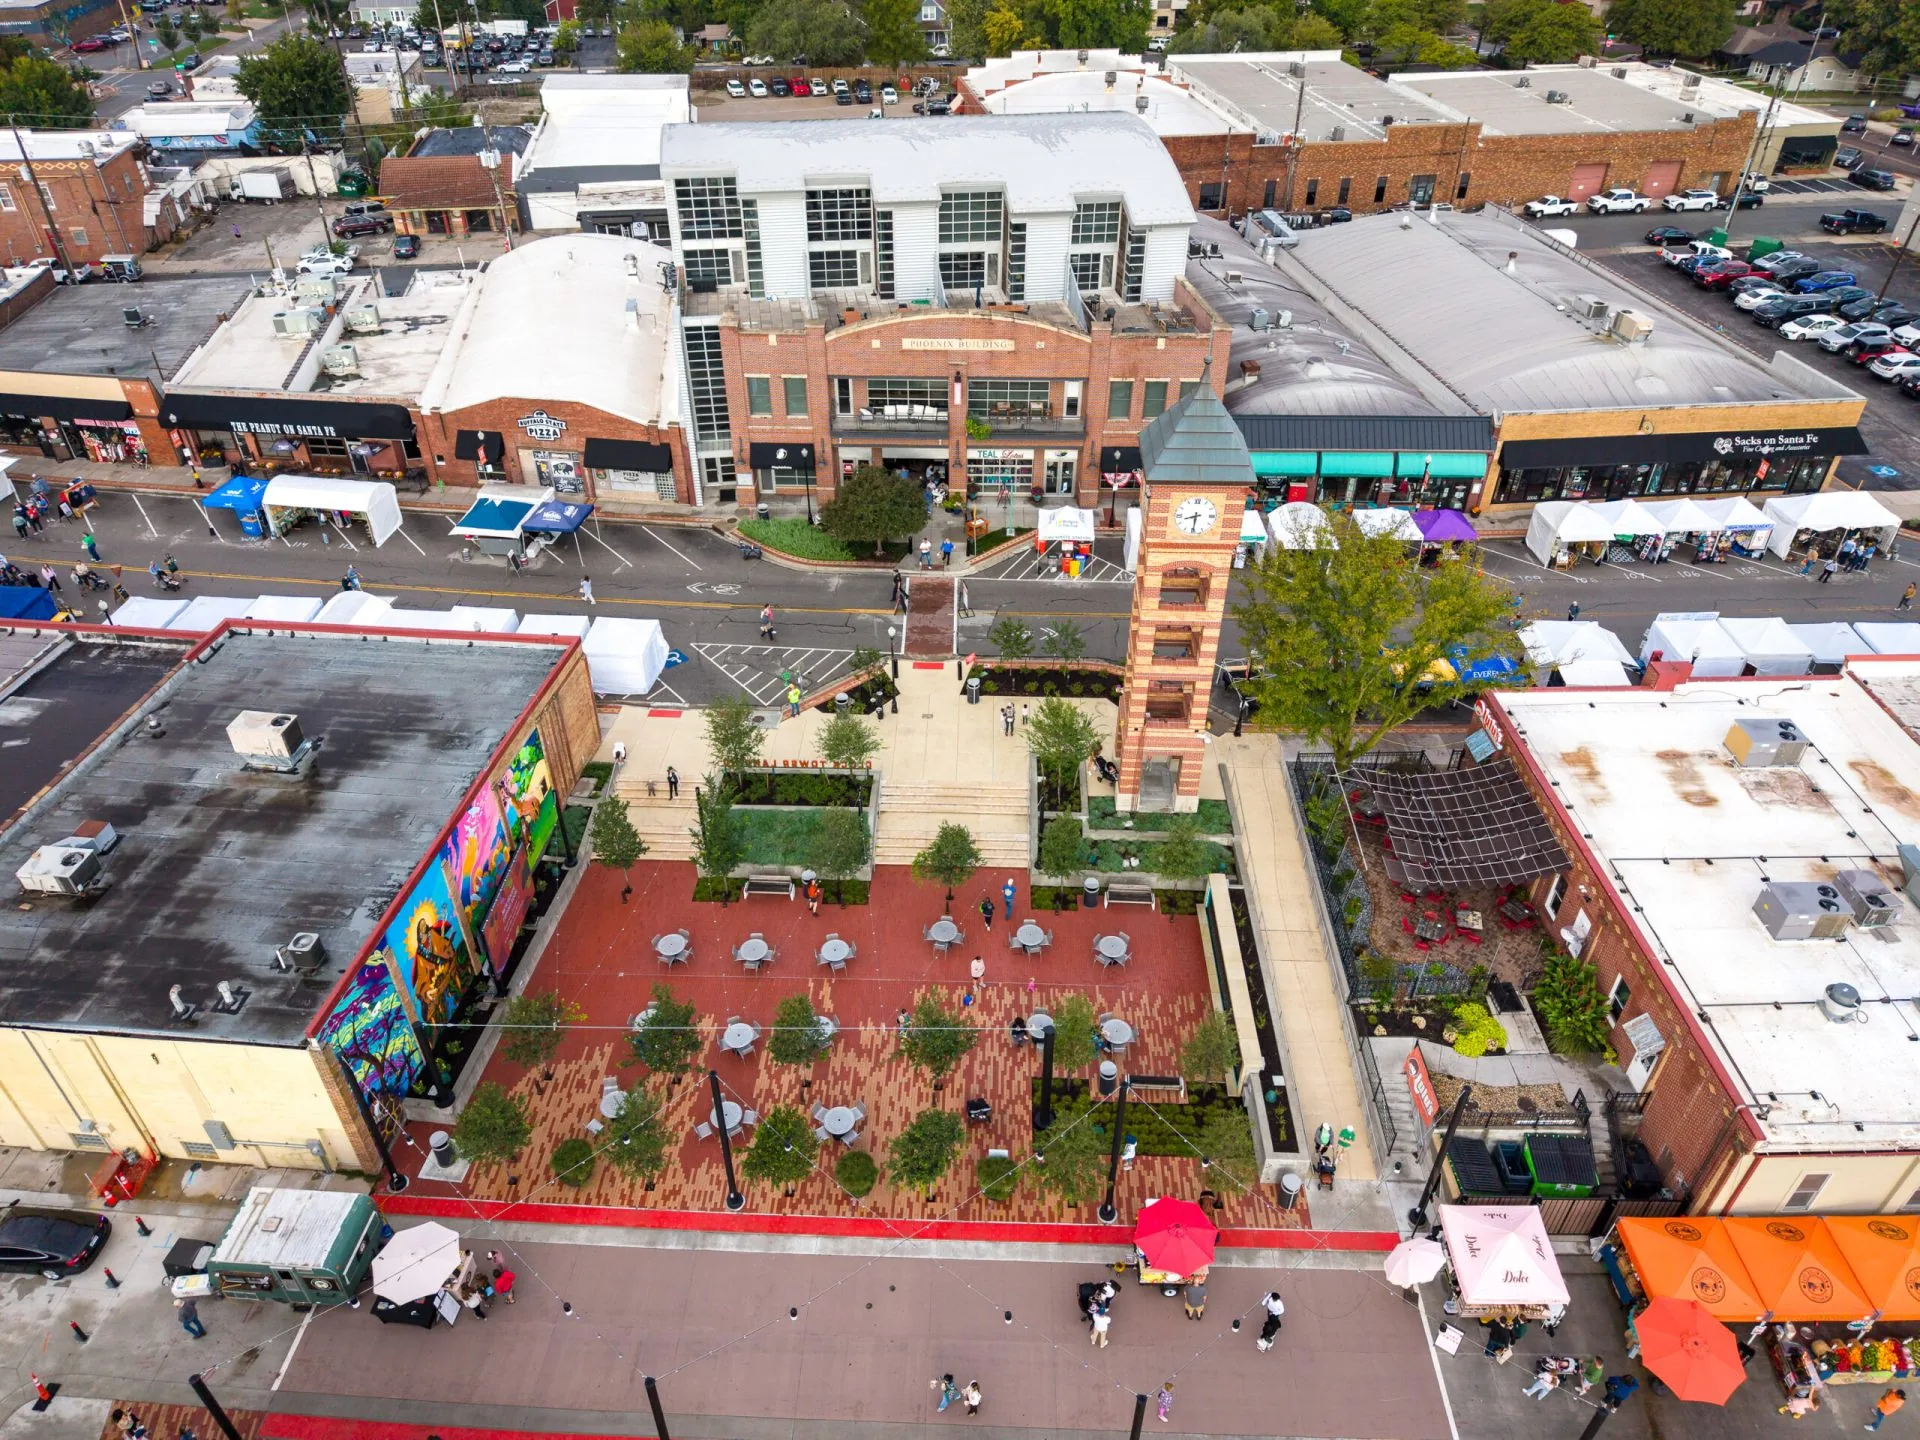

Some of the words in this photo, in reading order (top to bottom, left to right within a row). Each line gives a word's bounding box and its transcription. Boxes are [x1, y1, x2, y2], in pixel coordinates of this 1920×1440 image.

[910, 340, 954, 348] PHOENIX
[958, 340, 1007, 349] BUILDING
[519, 418, 544, 426] BUFFALO
[545, 420, 564, 428] STATE
[230, 421, 248, 432] THE
[249, 422, 281, 434] PEANUT
[283, 424, 296, 434] ON
[297, 425, 322, 436] SANTA
[324, 426, 336, 437] FE
[528, 427, 559, 437] PIZZA
[1734, 436, 1761, 446] Sacks
[1763, 437, 1776, 445] on
[1778, 434, 1804, 444] Santa
[1806, 433, 1818, 443] Fe
[977, 450, 998, 459] TEAL
[1000, 449, 1024, 459] Lotus
[1464, 1233, 1481, 1258] Dolce
[1502, 1270, 1529, 1283] Dolce
